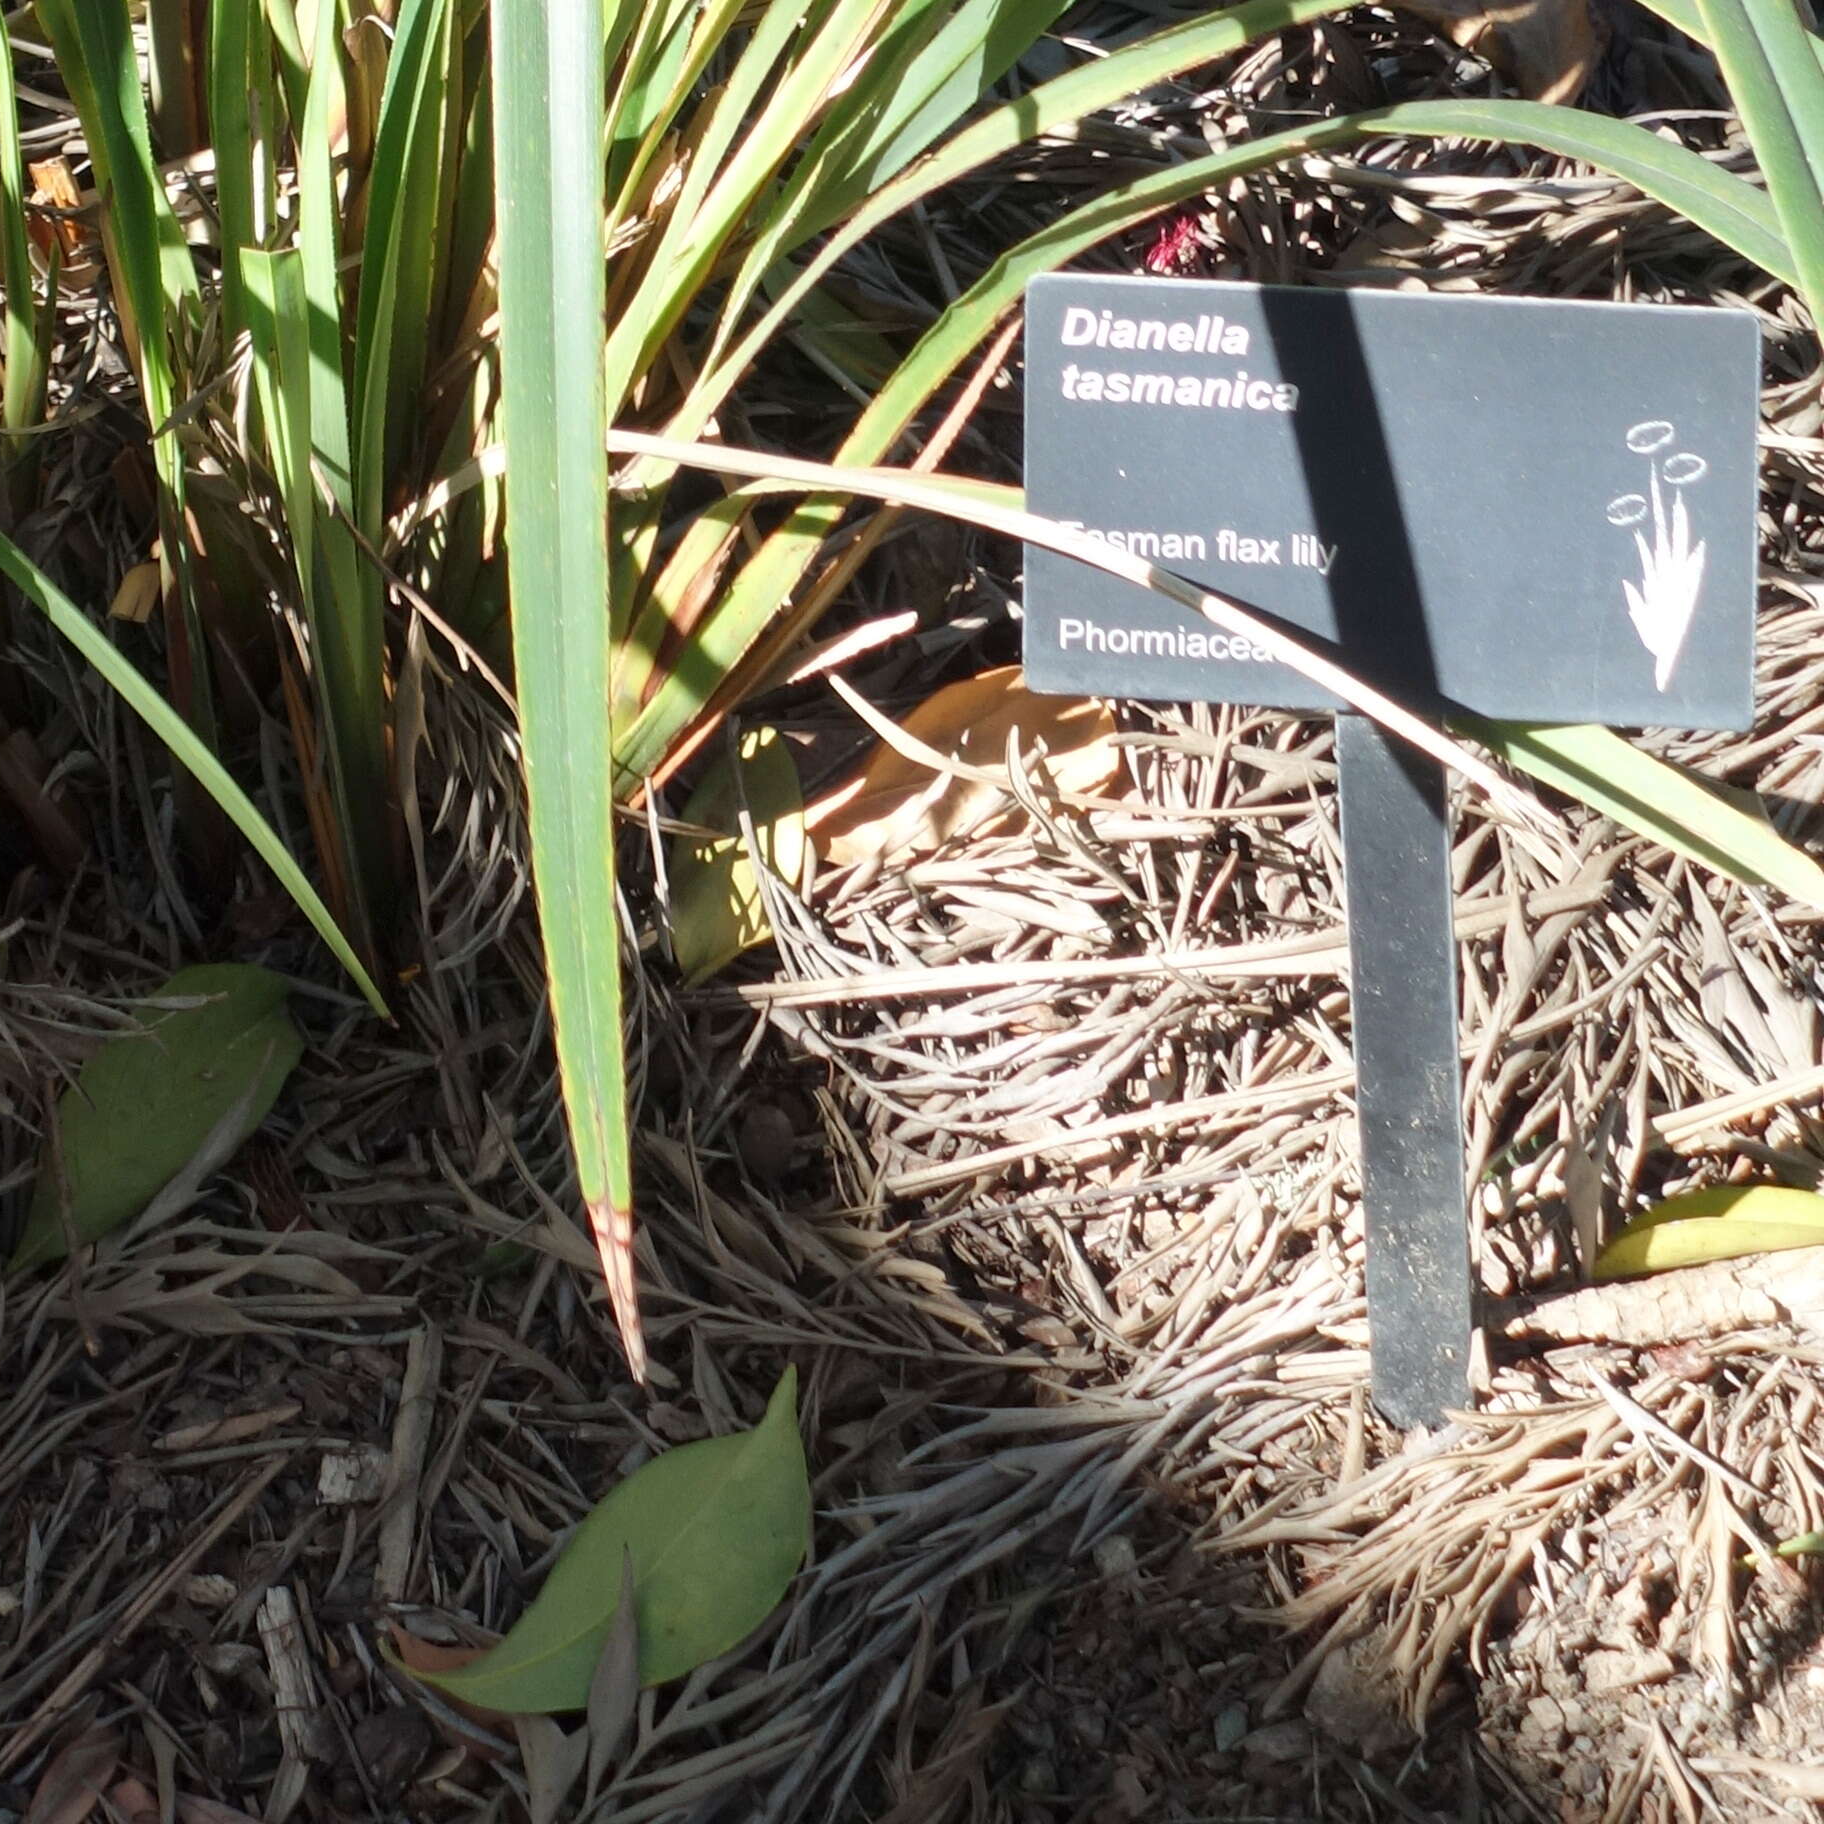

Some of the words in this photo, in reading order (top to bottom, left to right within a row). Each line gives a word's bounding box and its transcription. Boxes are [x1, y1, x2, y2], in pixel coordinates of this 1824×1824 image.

[1061, 306, 1250, 355] Dianella
[1061, 363, 1300, 411] tasmanica
[1216, 529, 1281, 566] flax
[1292, 534, 1338, 575] lily
[1059, 618, 1280, 663] Phormiacea
